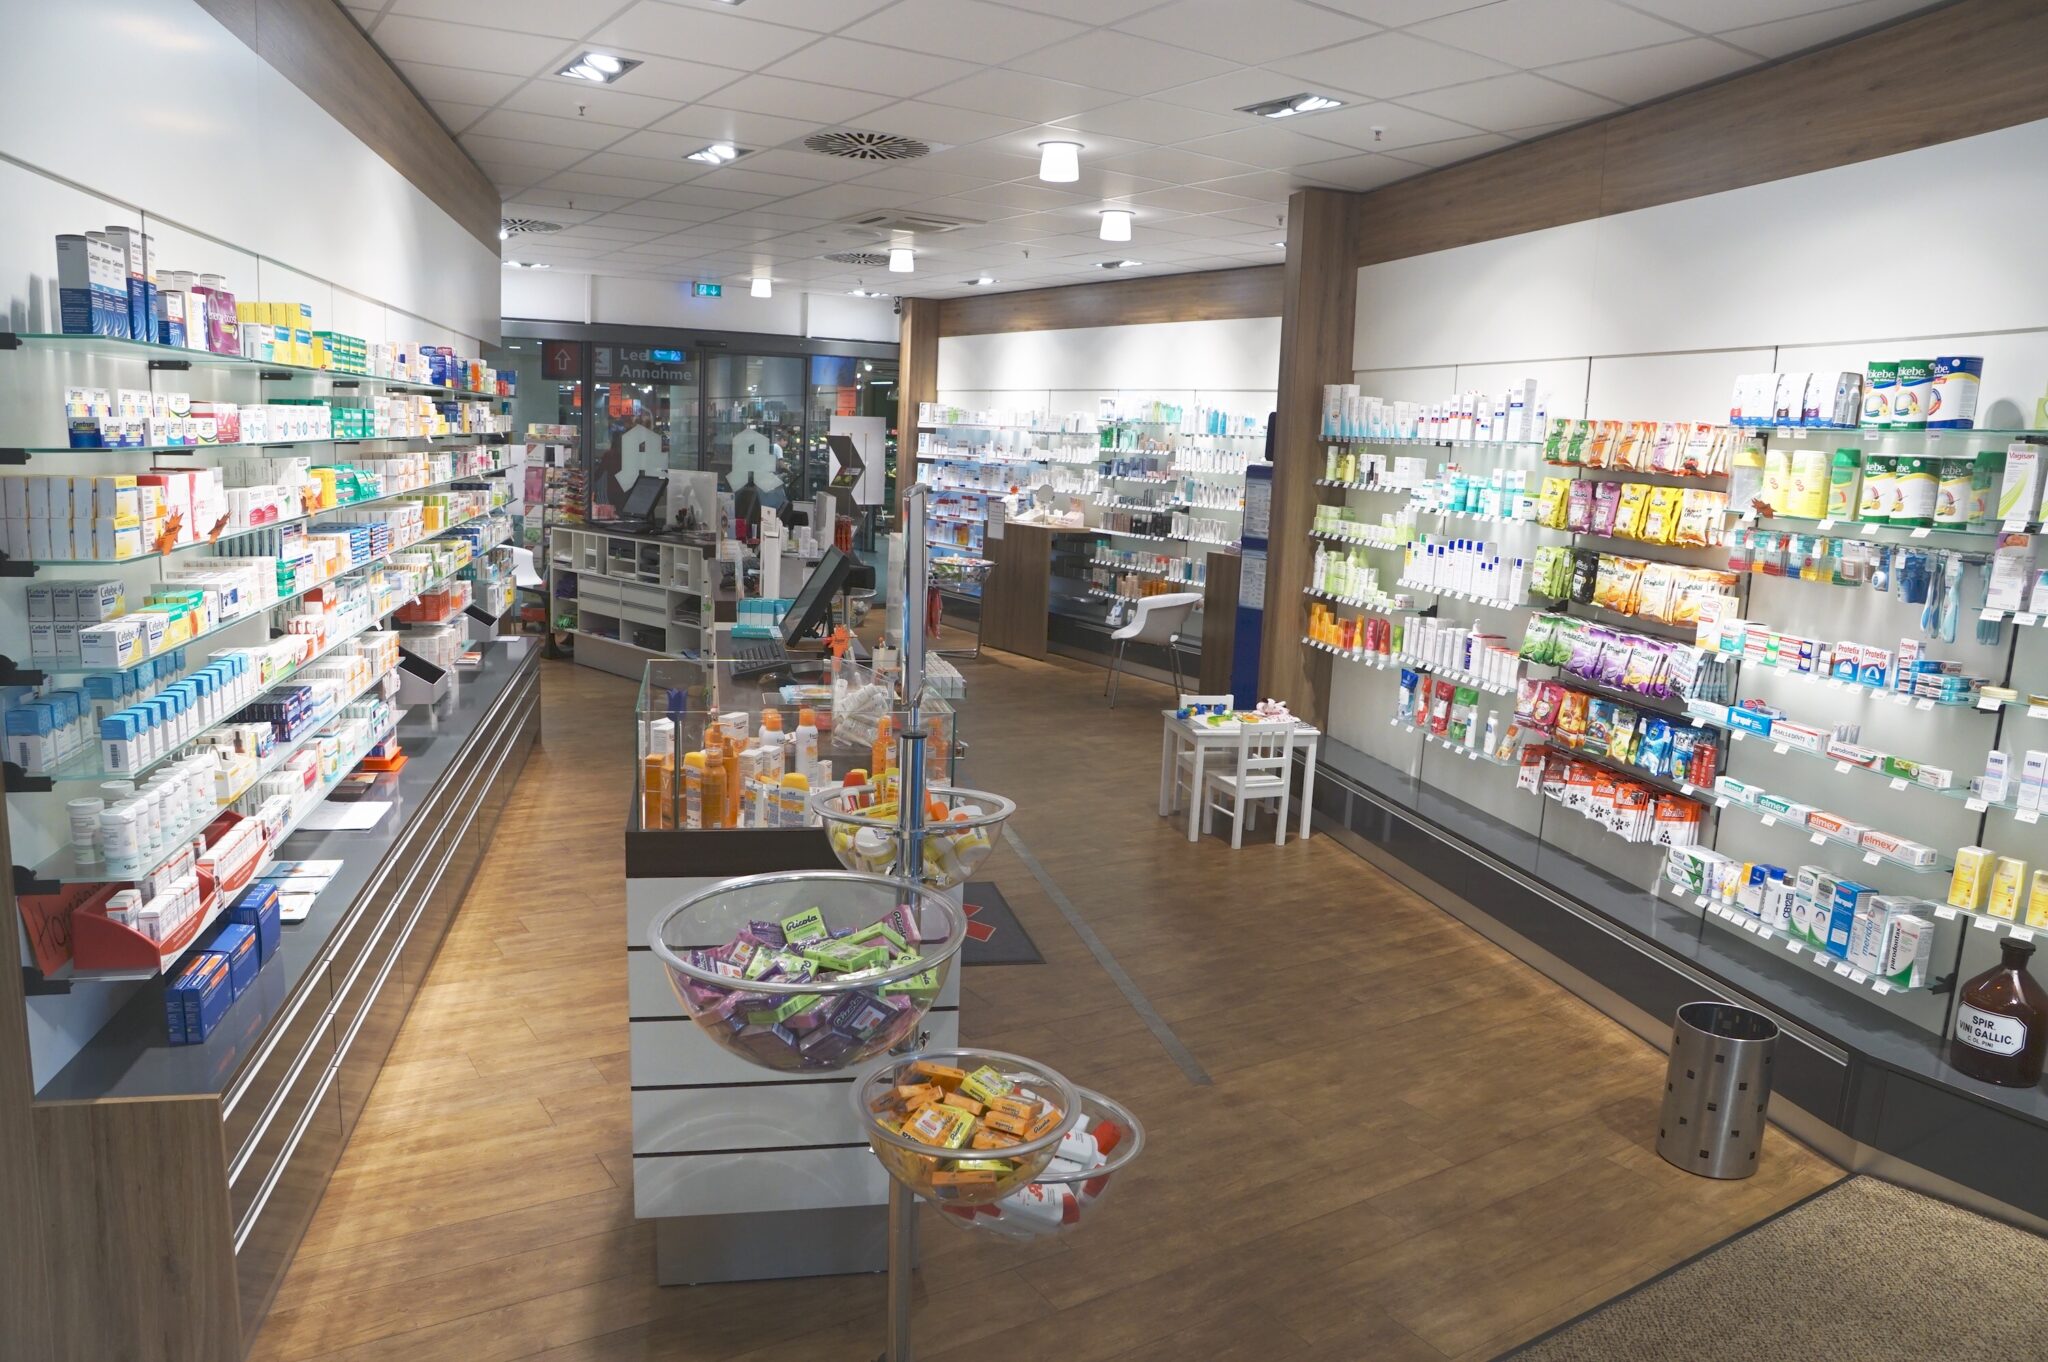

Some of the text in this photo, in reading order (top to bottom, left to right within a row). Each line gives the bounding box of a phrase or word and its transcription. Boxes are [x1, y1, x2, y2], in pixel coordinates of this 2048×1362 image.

[620, 365, 692, 381] Annahme
[2009, 451, 2035, 461] Vagisan
[1838, 644, 1860, 655] Protefix
[1864, 648, 1887, 660] Protefix
[1760, 796, 1788, 813] elmex
[1810, 814, 1840, 832] elmex
[1864, 834, 1893, 851] elmex
[786, 915, 818, 932] Ricola
[1862, 919, 1874, 956] meridol
[1890, 926, 1901, 970] parodontax
[1972, 1016, 1996, 1030] SPIR.
[1960, 1020, 2014, 1046] VINI GALLIC.
[1033, 1118, 1051, 1134] Ricola
